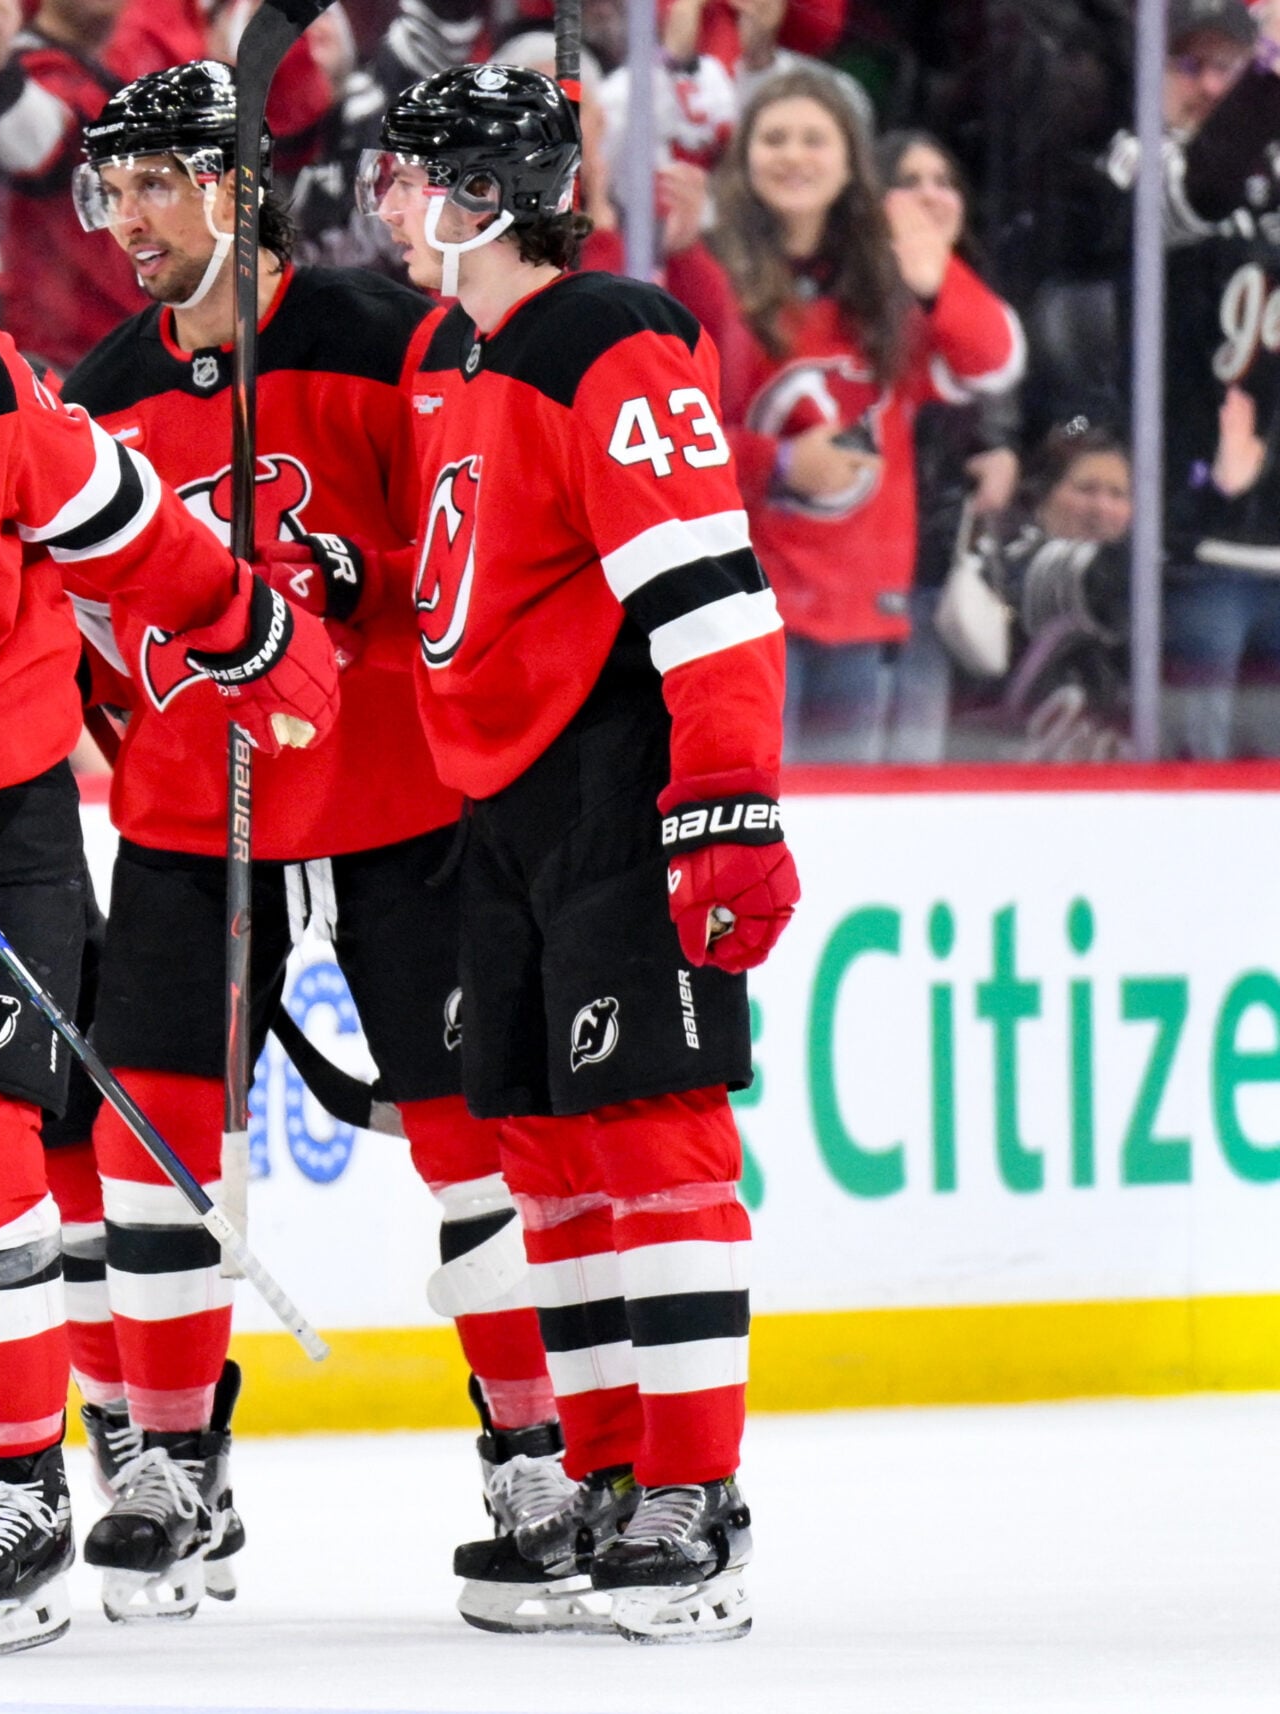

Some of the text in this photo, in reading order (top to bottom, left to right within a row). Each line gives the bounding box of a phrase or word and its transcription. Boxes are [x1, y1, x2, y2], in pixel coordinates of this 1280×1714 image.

[239, 164, 255, 281] FLYLITE
[608, 387, 731, 478] 43
[234, 738, 251, 864] BAUER
[662, 803, 782, 844] BAUER
[678, 969, 700, 1050] BAUER
[806, 894, 1280, 1202] Citize
